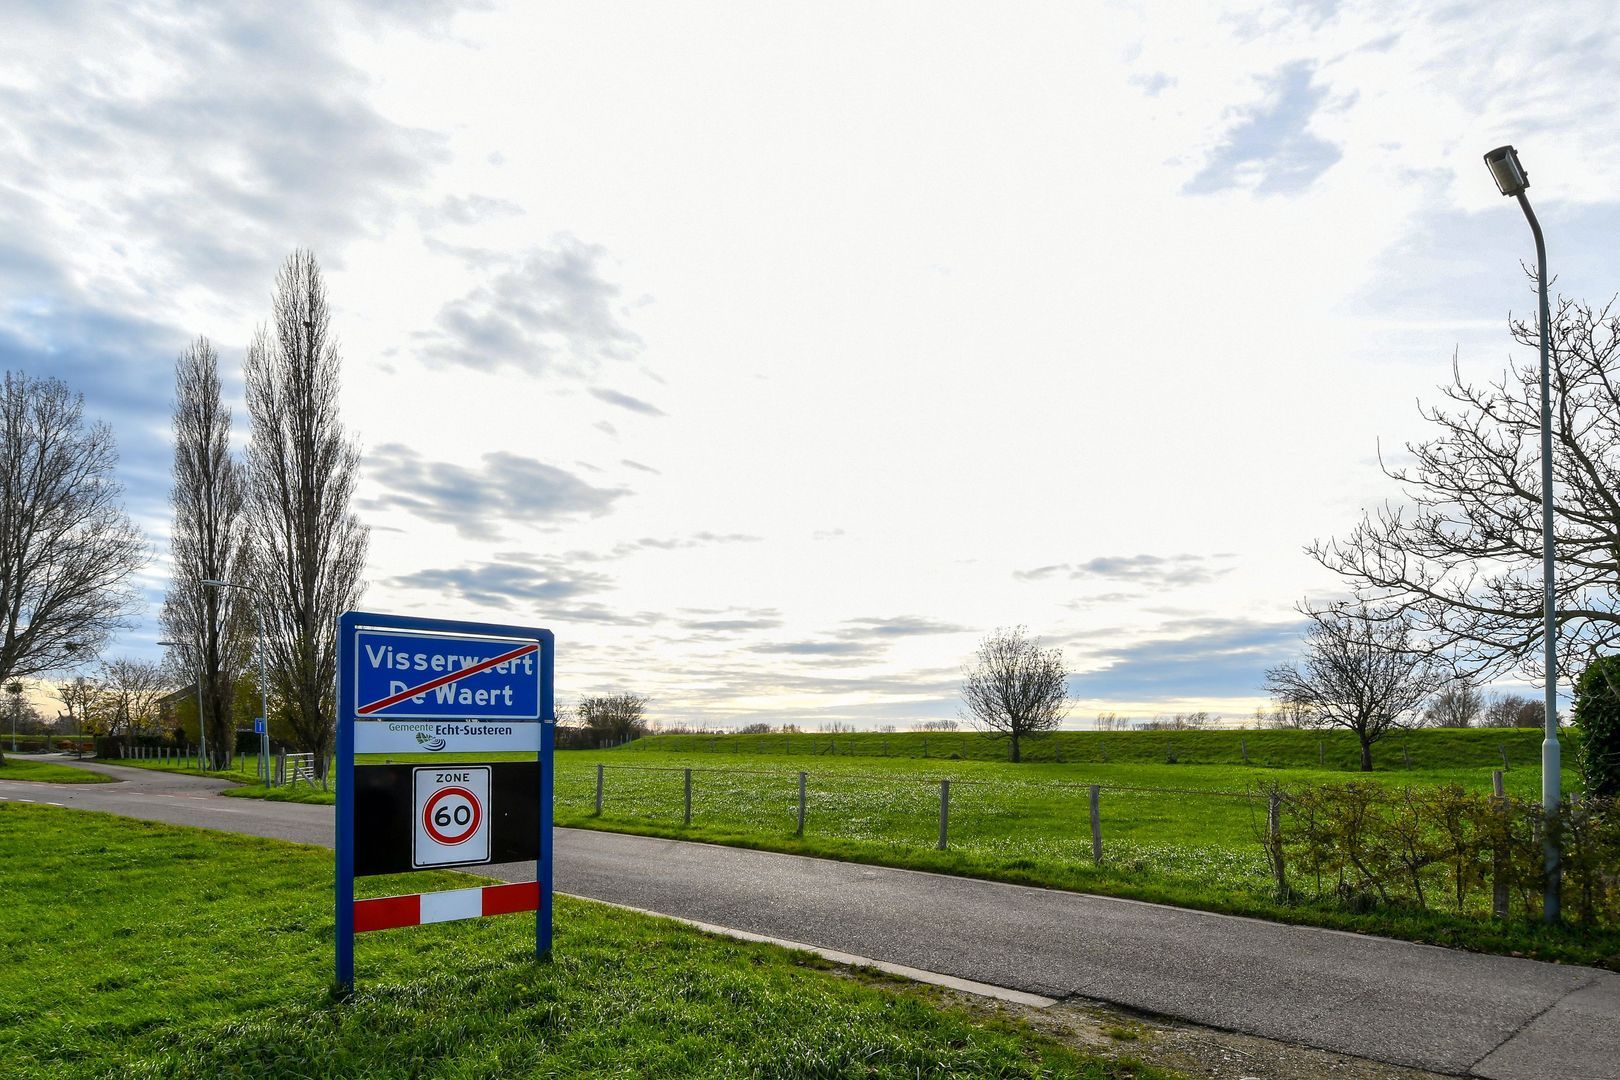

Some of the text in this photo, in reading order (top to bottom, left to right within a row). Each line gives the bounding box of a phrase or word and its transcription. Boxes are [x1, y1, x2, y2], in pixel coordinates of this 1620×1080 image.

[435, 683, 513, 706] Waert
[389, 723, 512, 736] Gemeente Echt-Susteren
[436, 774, 470, 783] ZONE
[435, 805, 471, 826] 60
